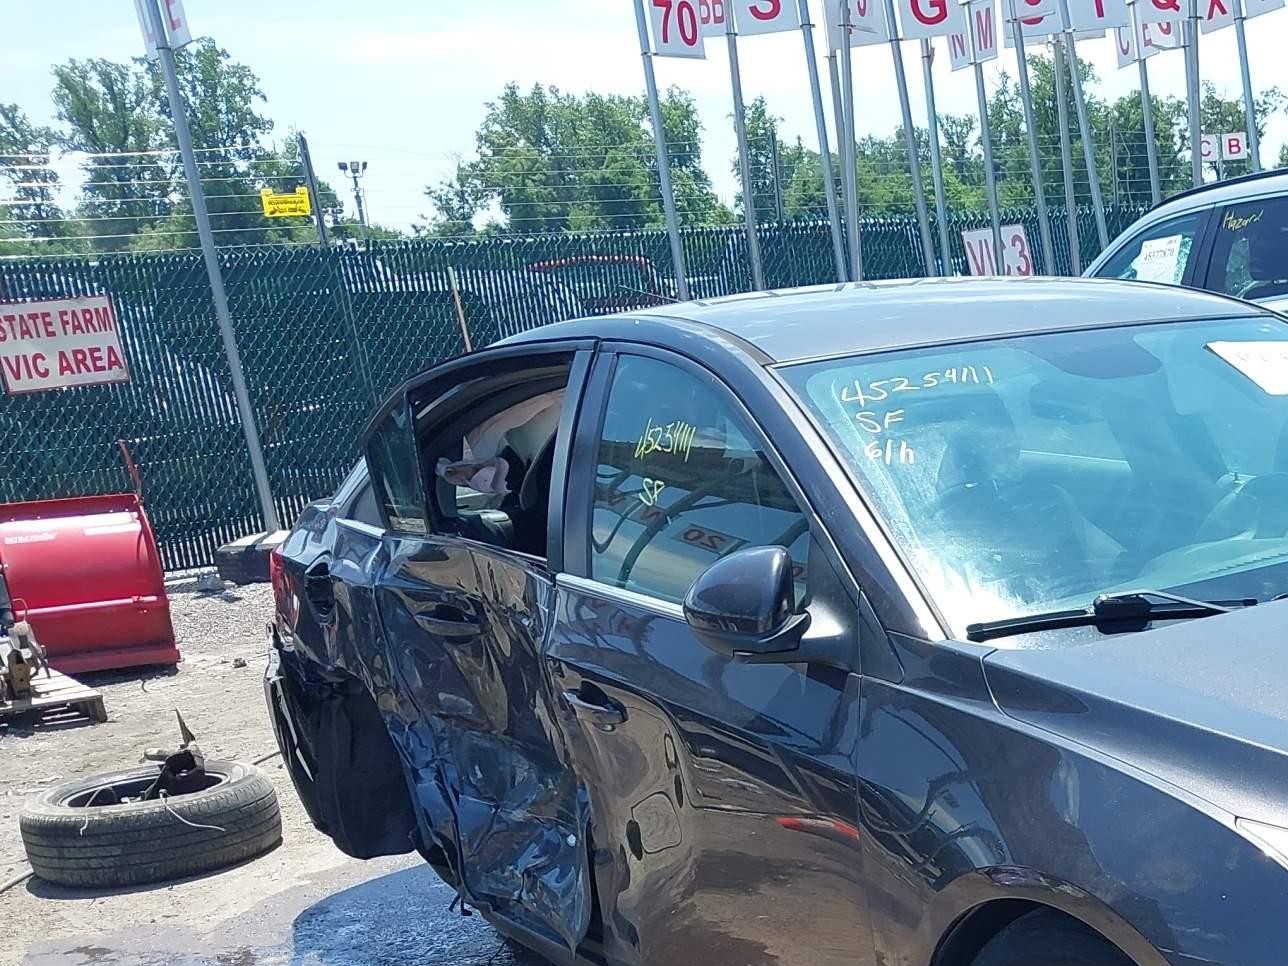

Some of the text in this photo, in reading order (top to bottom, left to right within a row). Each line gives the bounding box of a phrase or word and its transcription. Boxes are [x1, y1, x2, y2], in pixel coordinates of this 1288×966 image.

[653, 0, 698, 46] 70
[1228, 138, 1241, 155] B
[58, 307, 113, 336] FARM
[3, 345, 123, 381] VIC AREA
[855, 410, 905, 433] SF
